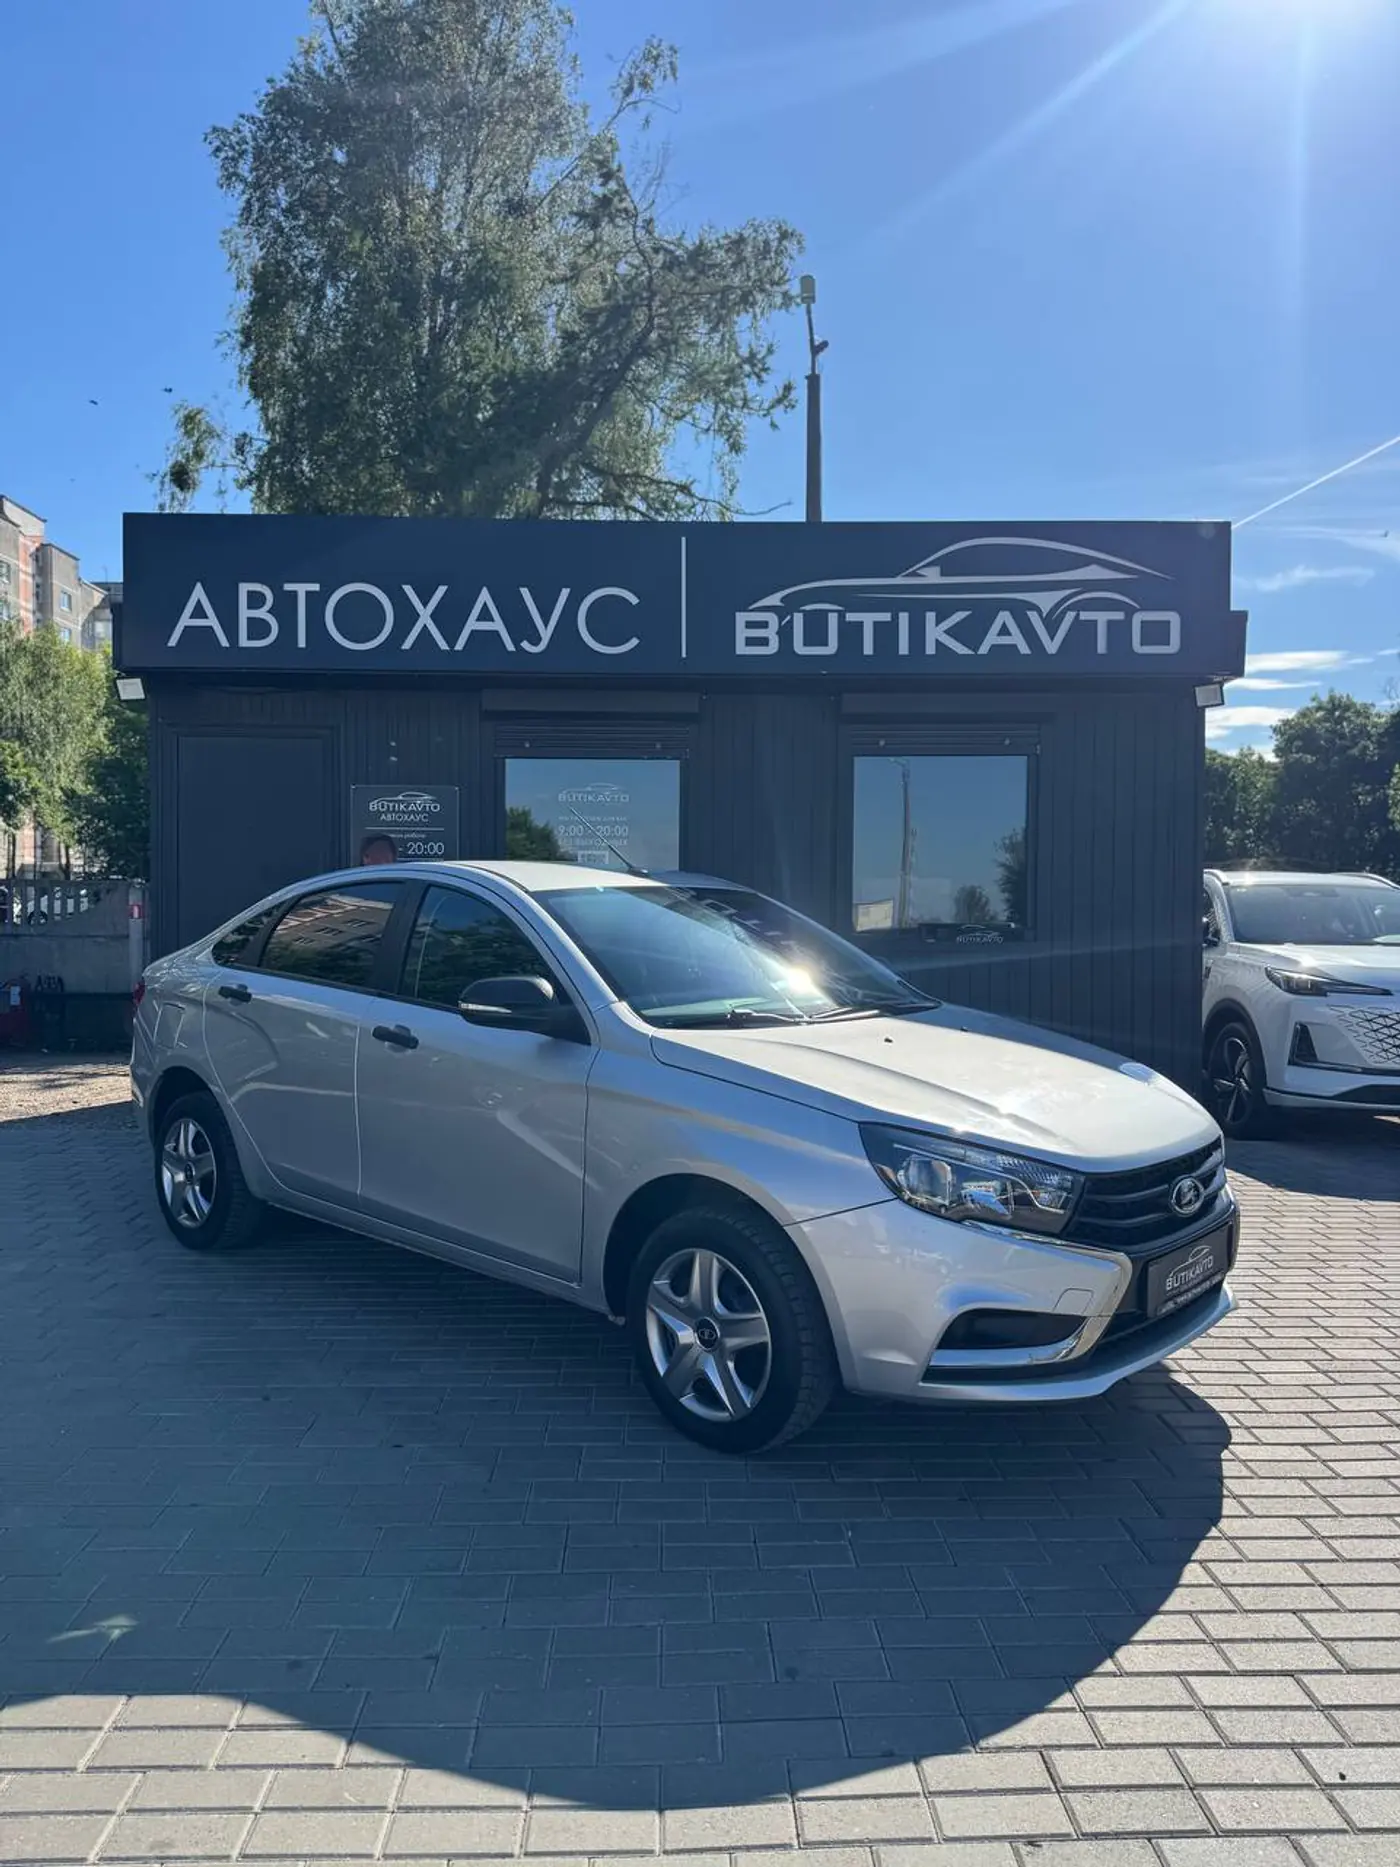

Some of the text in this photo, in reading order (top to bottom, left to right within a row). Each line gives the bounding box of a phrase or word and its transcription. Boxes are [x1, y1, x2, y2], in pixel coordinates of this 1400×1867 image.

[167, 581, 641, 654] АВТОХАУС
[735, 609, 1181, 655] BUTIKAVTO
[558, 792, 629, 802] BUTIKAVTO
[369, 802, 441, 812] BUTIKAVTO
[380, 813, 429, 822] АВТОХАУС
[407, 842, 445, 855] 20:00
[1165, 1255, 1214, 1291] BUTIKAVTO
